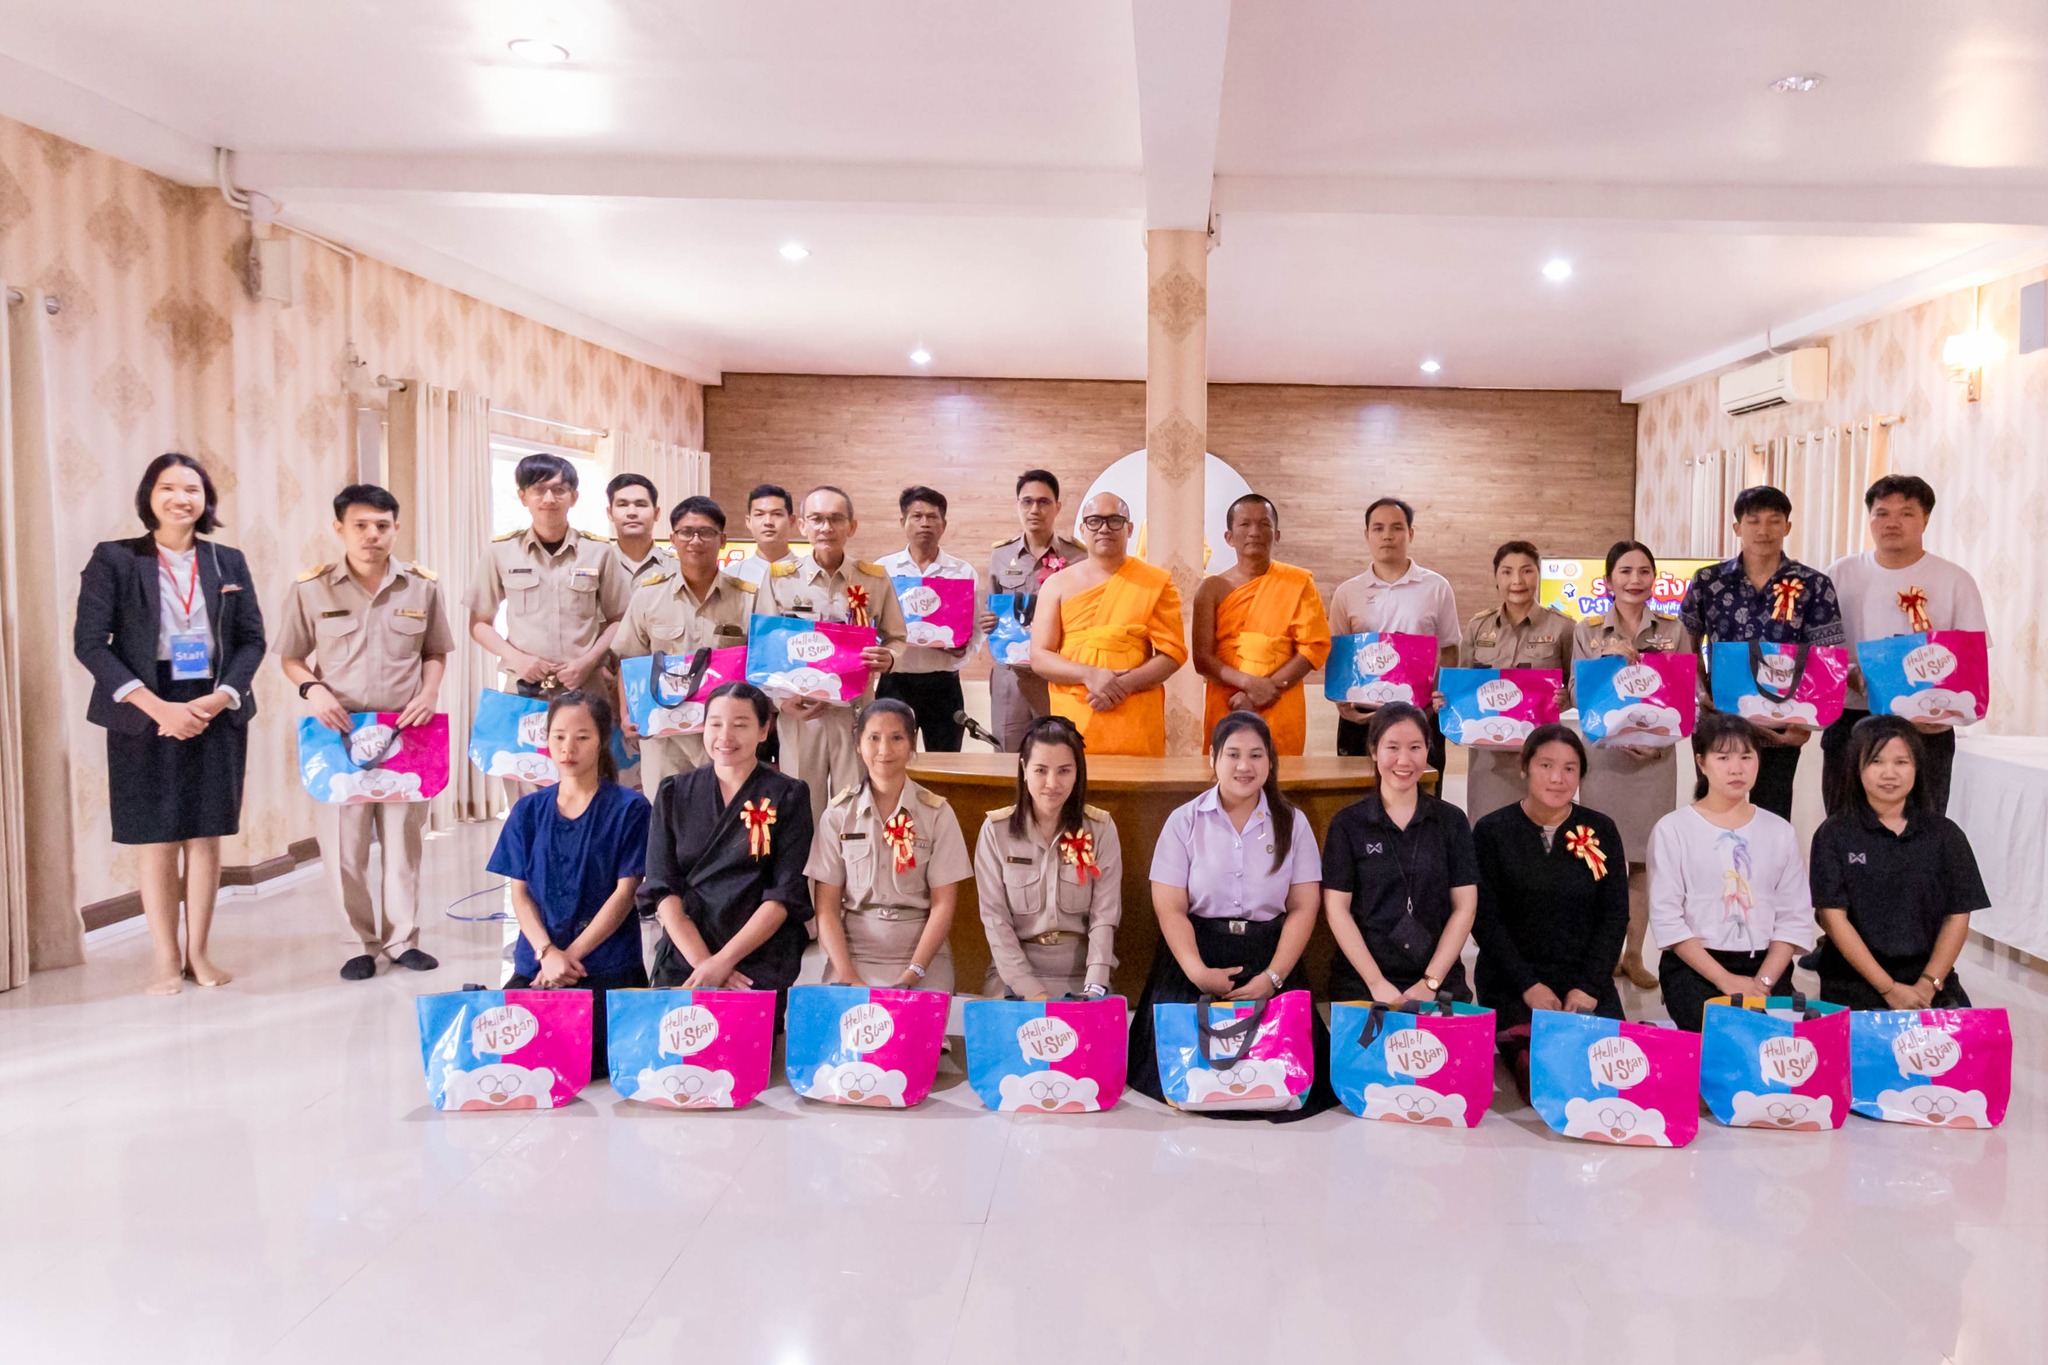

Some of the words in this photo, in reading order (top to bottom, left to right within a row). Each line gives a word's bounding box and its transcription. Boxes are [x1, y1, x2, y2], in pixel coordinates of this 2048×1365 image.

[1581, 599, 1611, 613] V-ST
[175, 650, 205, 661] Staff
[664, 1008, 697, 1032] Hello!!
[1022, 1019, 1053, 1041] Hello!!
[486, 1019, 533, 1049] V-Star
[671, 1022, 714, 1050] V-Star
[1031, 1031, 1073, 1056] V-Star
[1389, 1031, 1423, 1052] Hello!!
[1398, 1047, 1443, 1072] V-Star
[1592, 1039, 1625, 1061] Hello!!
[1764, 1038, 1800, 1057] Hello!!
[1909, 1041, 1954, 1071] V-Star
[1601, 1056, 1644, 1082] V-Star
[1773, 1050, 1816, 1078] V-Star
